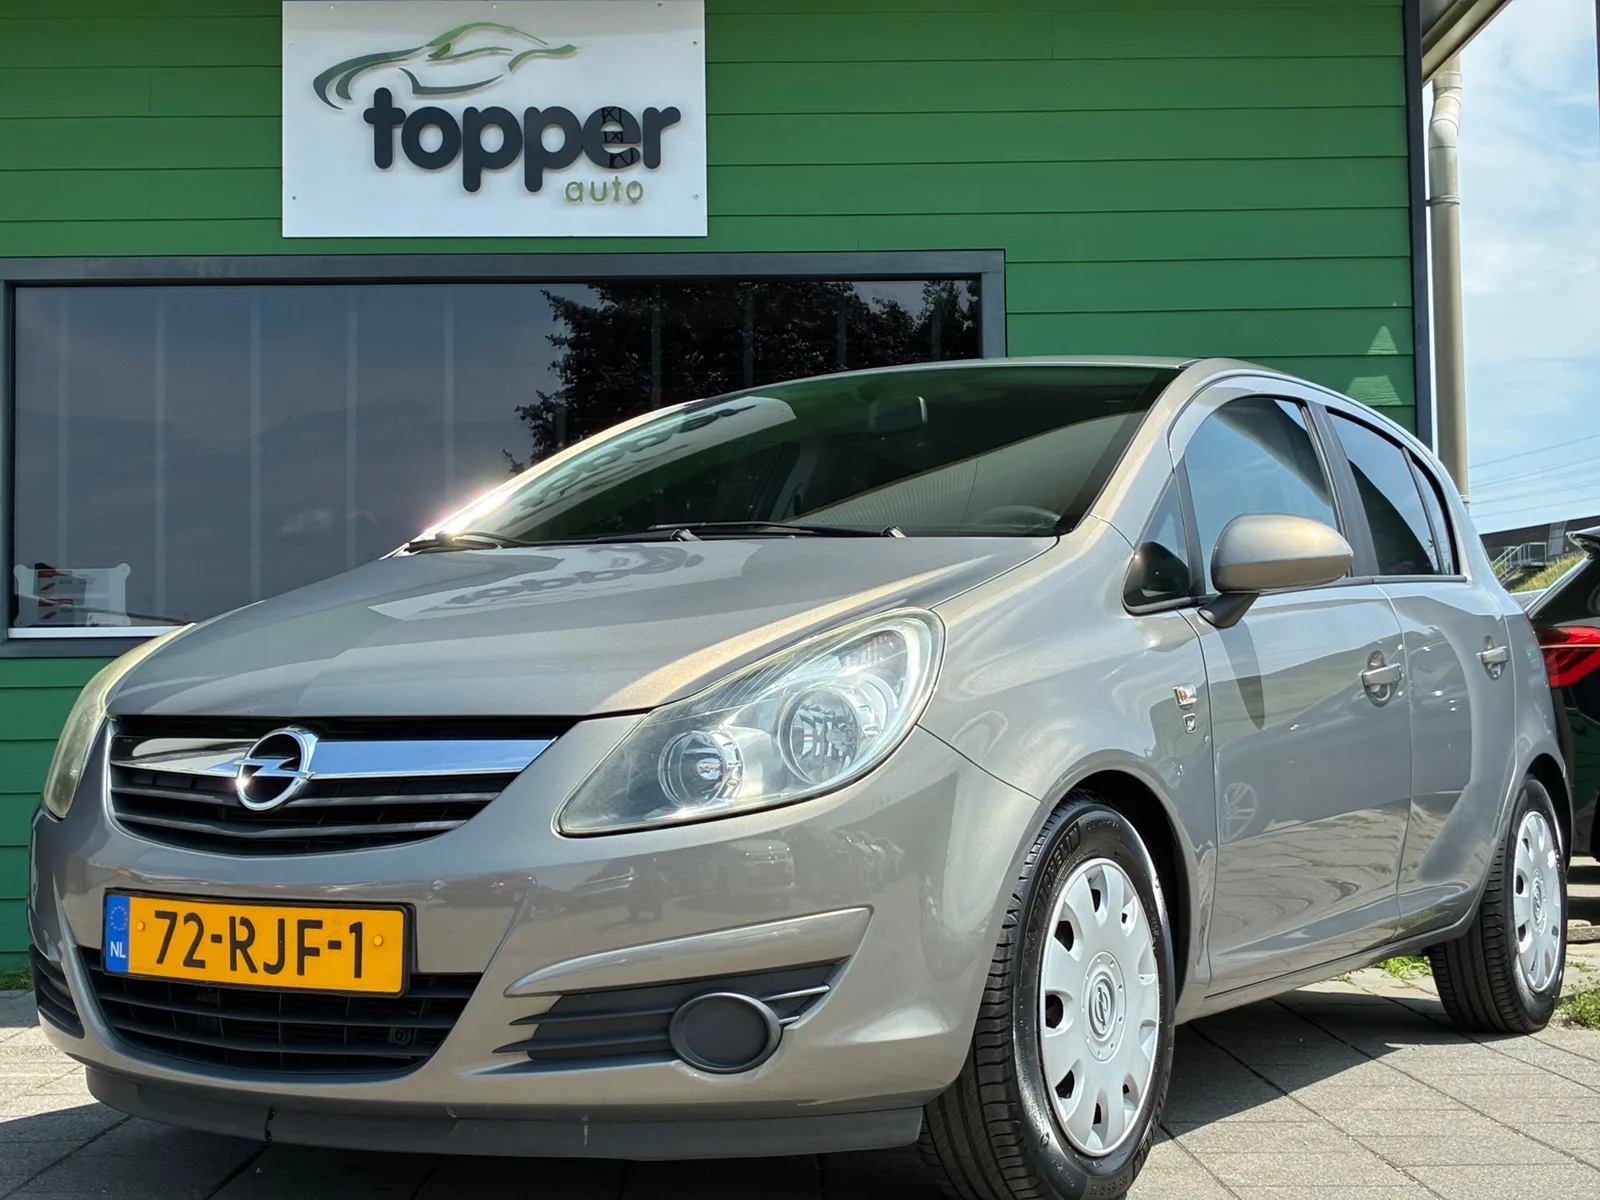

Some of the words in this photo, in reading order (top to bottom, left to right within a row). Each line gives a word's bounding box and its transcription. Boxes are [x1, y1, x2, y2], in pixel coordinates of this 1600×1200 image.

[363, 87, 681, 193] topper
[565, 176, 644, 204] auto
[109, 940, 127, 959] NL
[154, 909, 363, 979] 72-RJF-1
